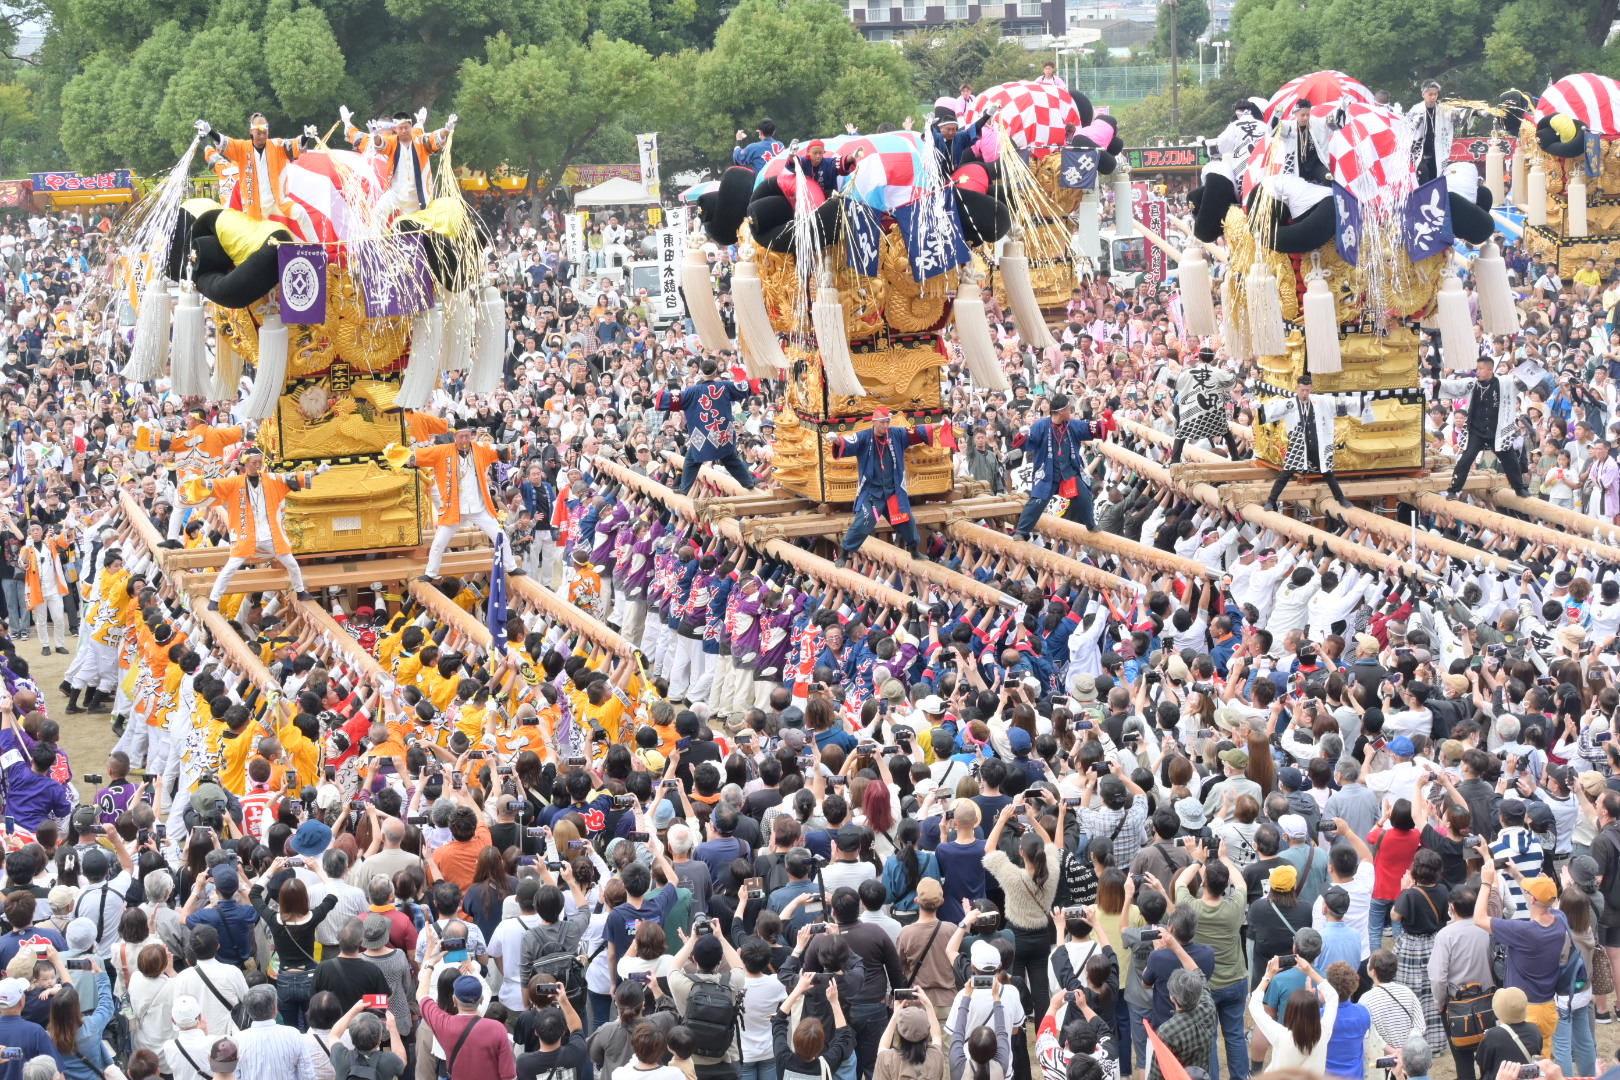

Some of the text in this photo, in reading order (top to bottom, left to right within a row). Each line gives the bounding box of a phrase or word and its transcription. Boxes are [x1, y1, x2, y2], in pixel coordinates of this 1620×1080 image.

[1143, 150, 1196, 166] フランクフルト
[44, 172, 117, 191] やきそば
[577, 169, 642, 184] バナナチョコ
[698, 385, 733, 445] しもいずみ
